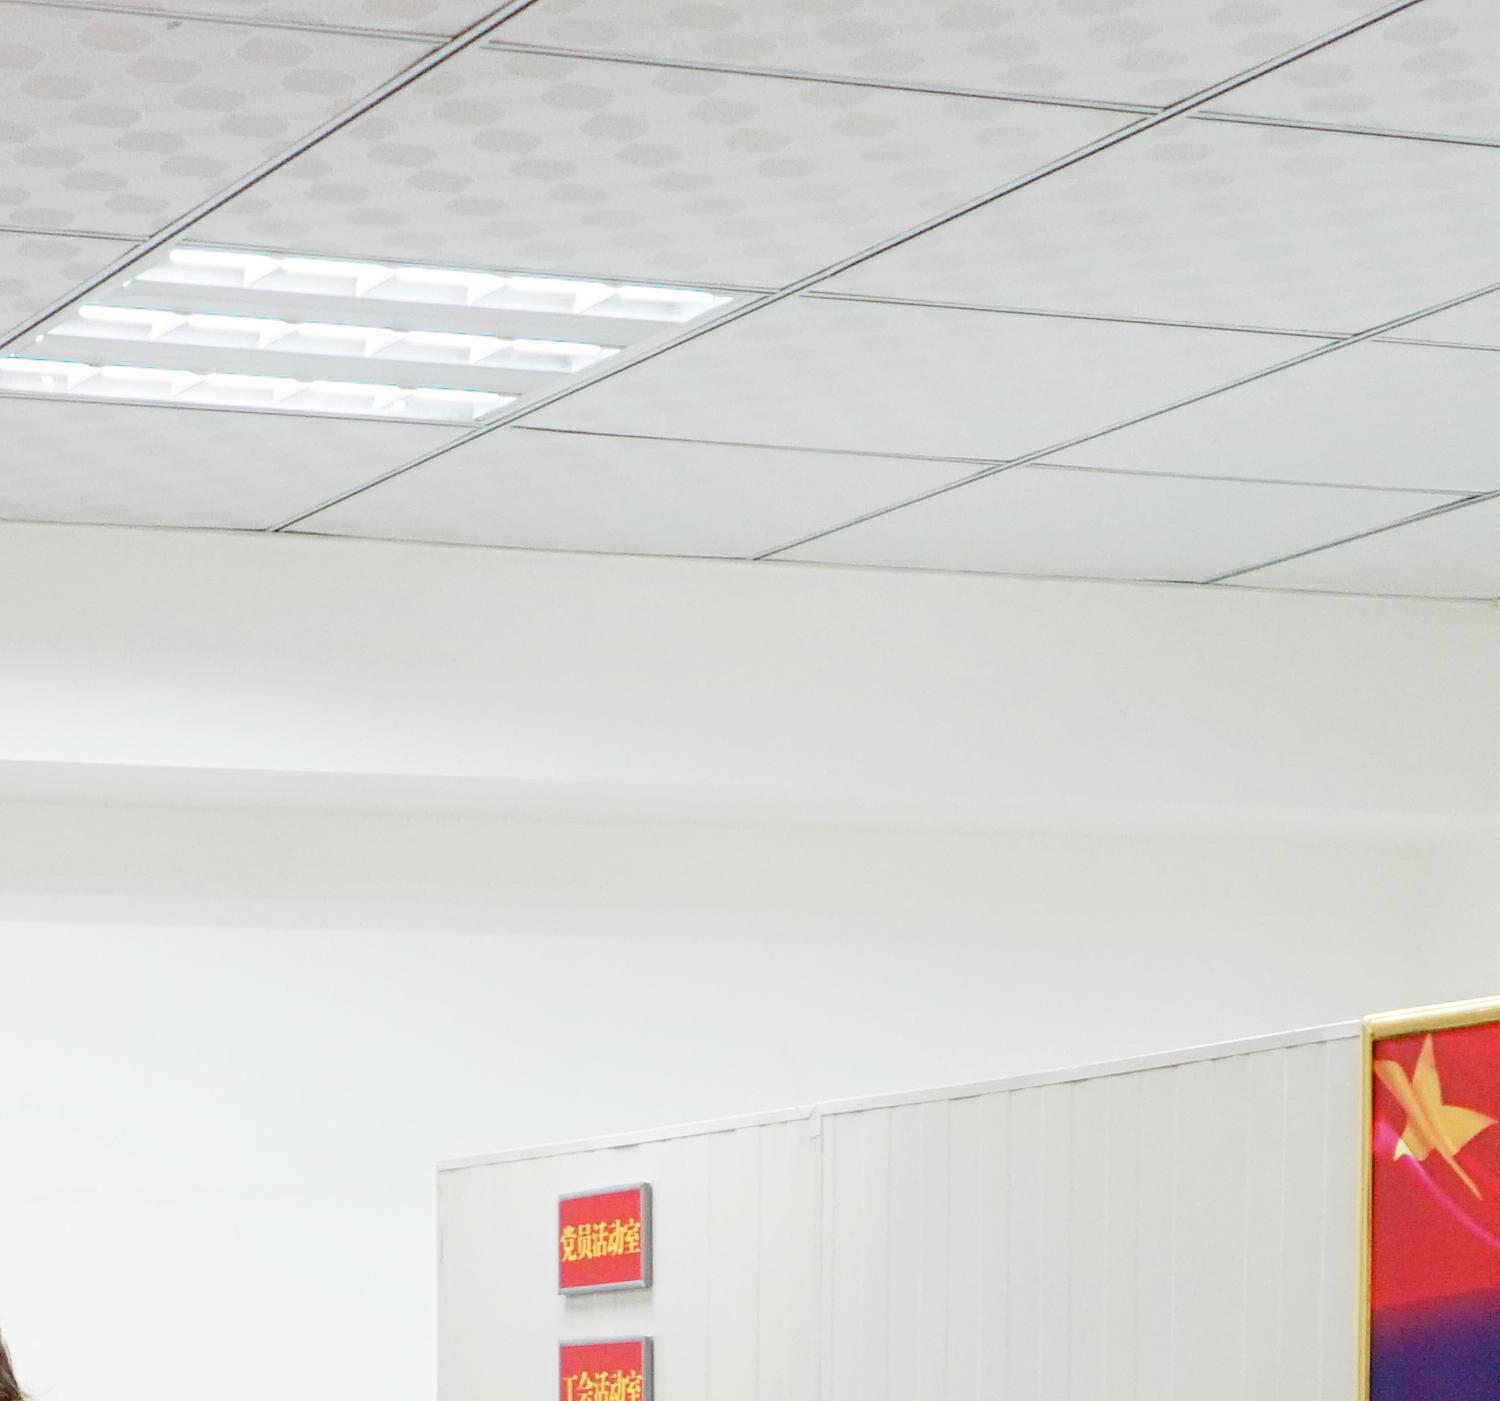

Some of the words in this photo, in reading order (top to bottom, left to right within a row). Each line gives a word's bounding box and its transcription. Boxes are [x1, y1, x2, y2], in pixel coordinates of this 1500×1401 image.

[559, 1217, 641, 1262] 党员活动室
